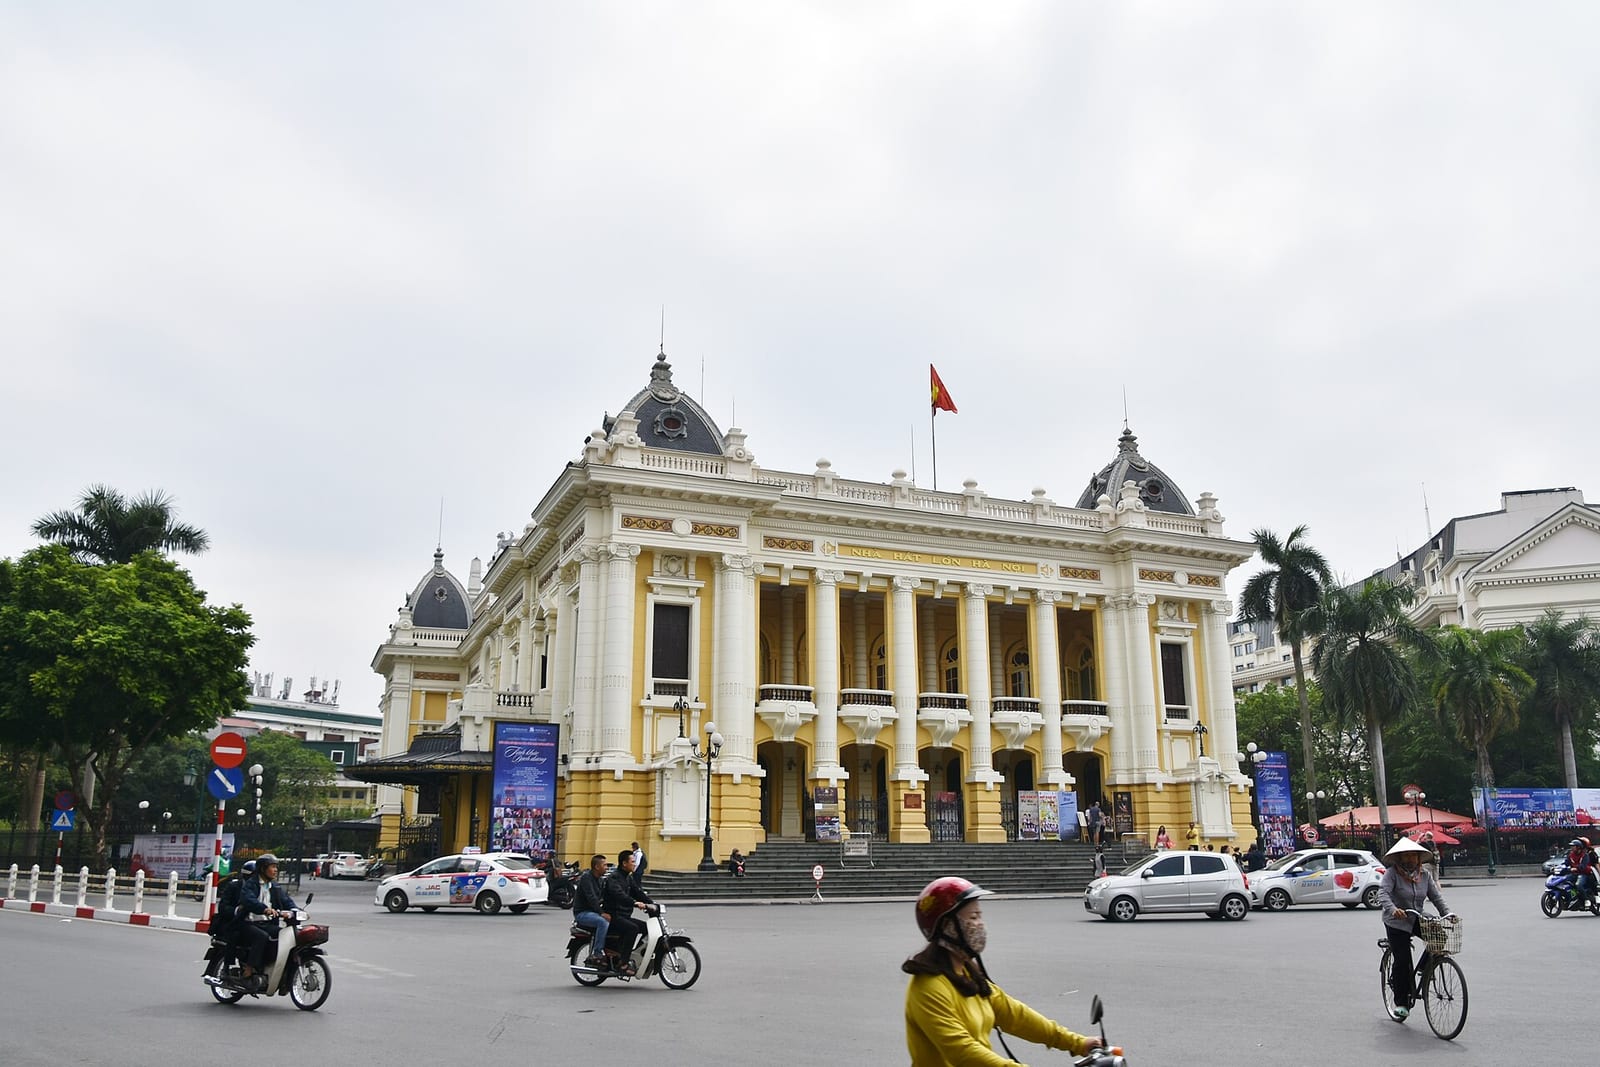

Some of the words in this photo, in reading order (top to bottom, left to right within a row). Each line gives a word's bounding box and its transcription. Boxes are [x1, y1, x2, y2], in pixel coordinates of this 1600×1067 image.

[851, 547, 882, 558] NHÀ
[894, 551, 921, 562] HÁT
[971, 558, 991, 569] HÀ
